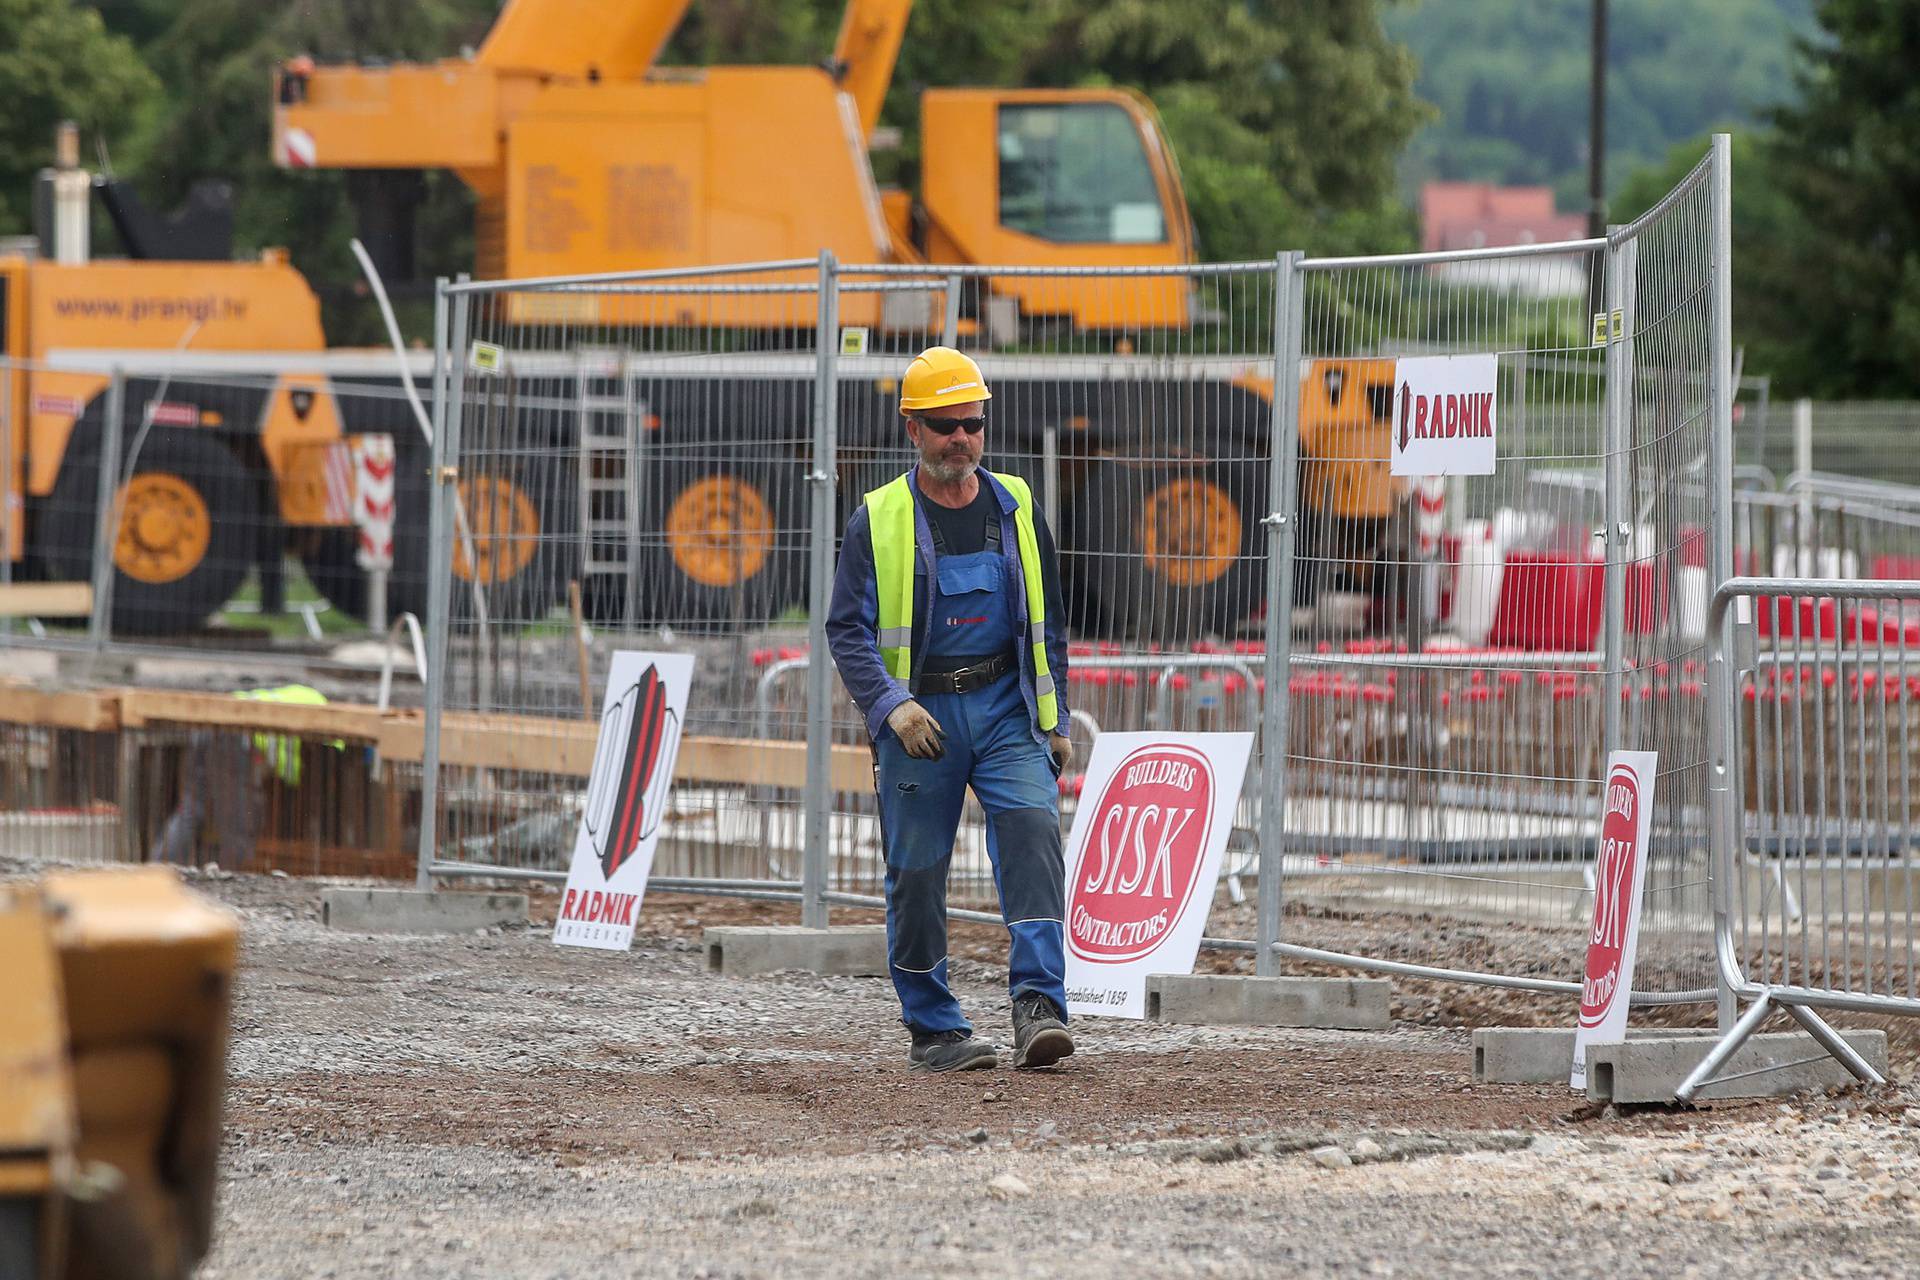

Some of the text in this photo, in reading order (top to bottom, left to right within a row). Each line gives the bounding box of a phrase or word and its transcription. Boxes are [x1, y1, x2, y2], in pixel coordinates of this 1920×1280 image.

[1414, 392, 1493, 439] RADNIK
[1123, 760, 1197, 792] BUILDERS
[1085, 803, 1196, 899] SISK
[562, 888, 638, 927] RADNIK
[1072, 904, 1168, 947] CONTRACTORS
[1105, 989, 1128, 1007] 1859
